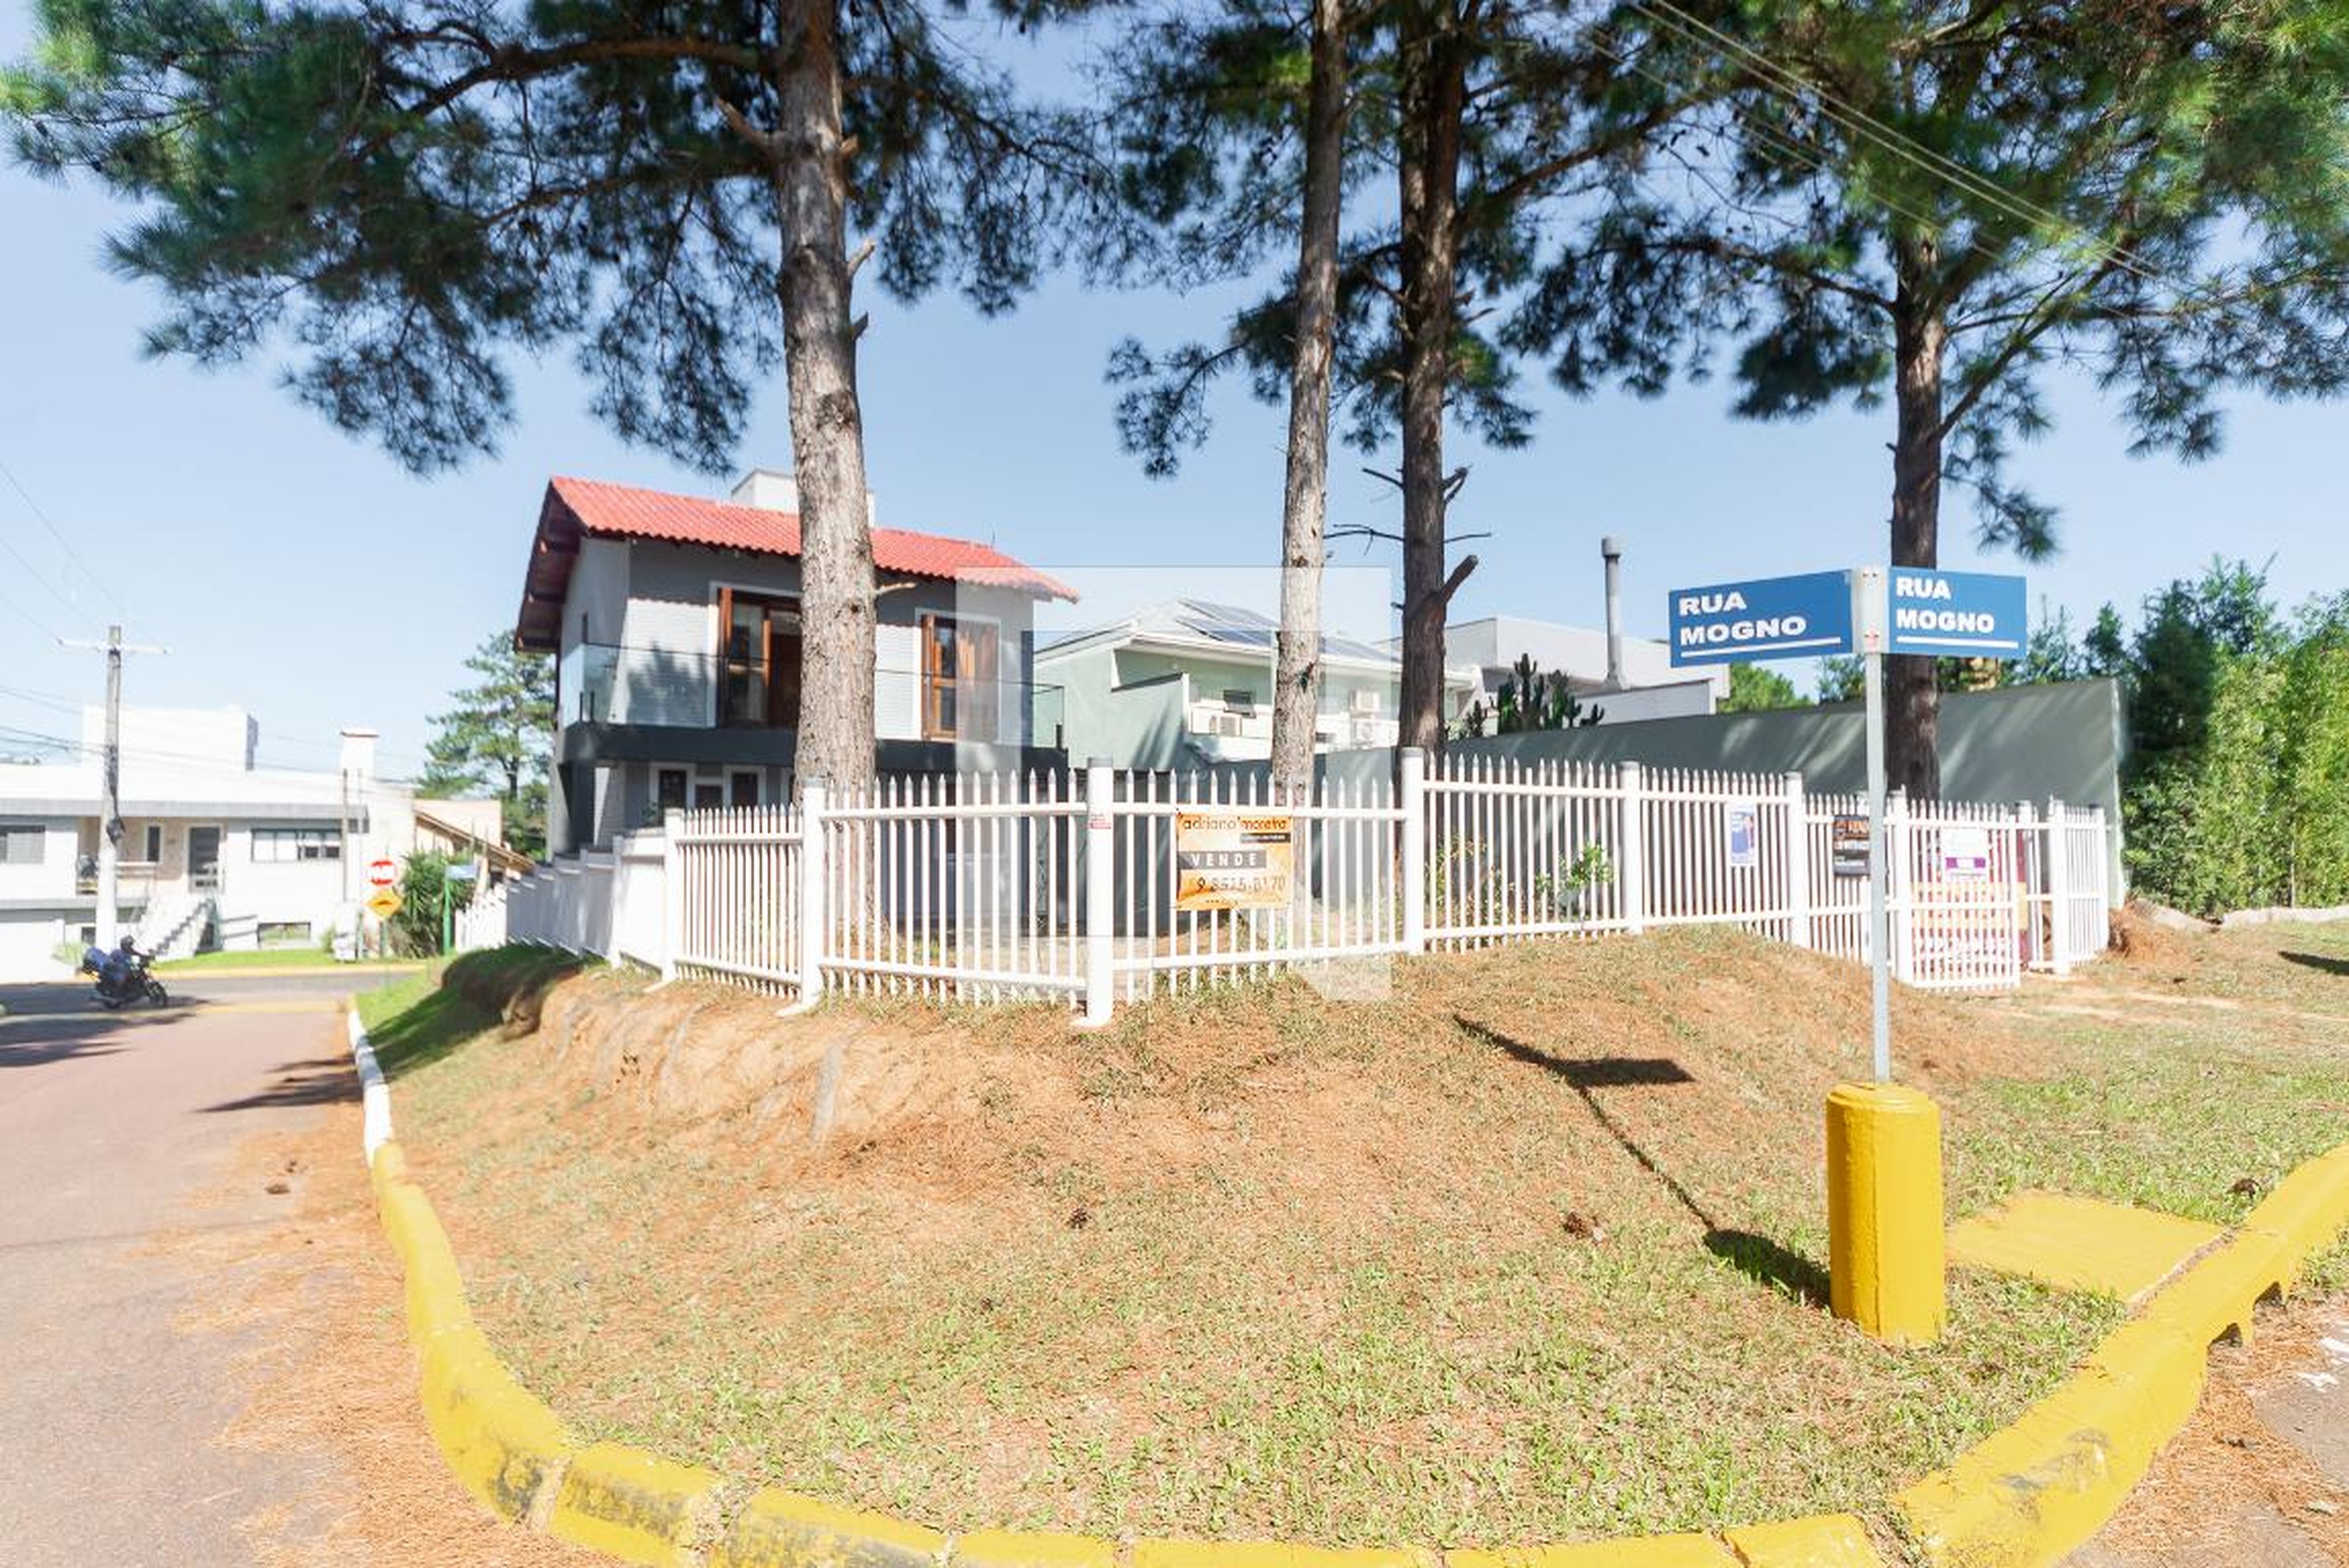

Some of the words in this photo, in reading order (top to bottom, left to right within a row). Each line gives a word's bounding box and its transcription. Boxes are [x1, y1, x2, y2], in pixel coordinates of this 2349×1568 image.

[1896, 577, 1951, 600] RUA
[1679, 591, 1746, 615] RUA
[1680, 616, 1807, 646] MOGNO
[1896, 608, 1995, 634] MOGNO
[1192, 852, 1258, 867] VENDE
